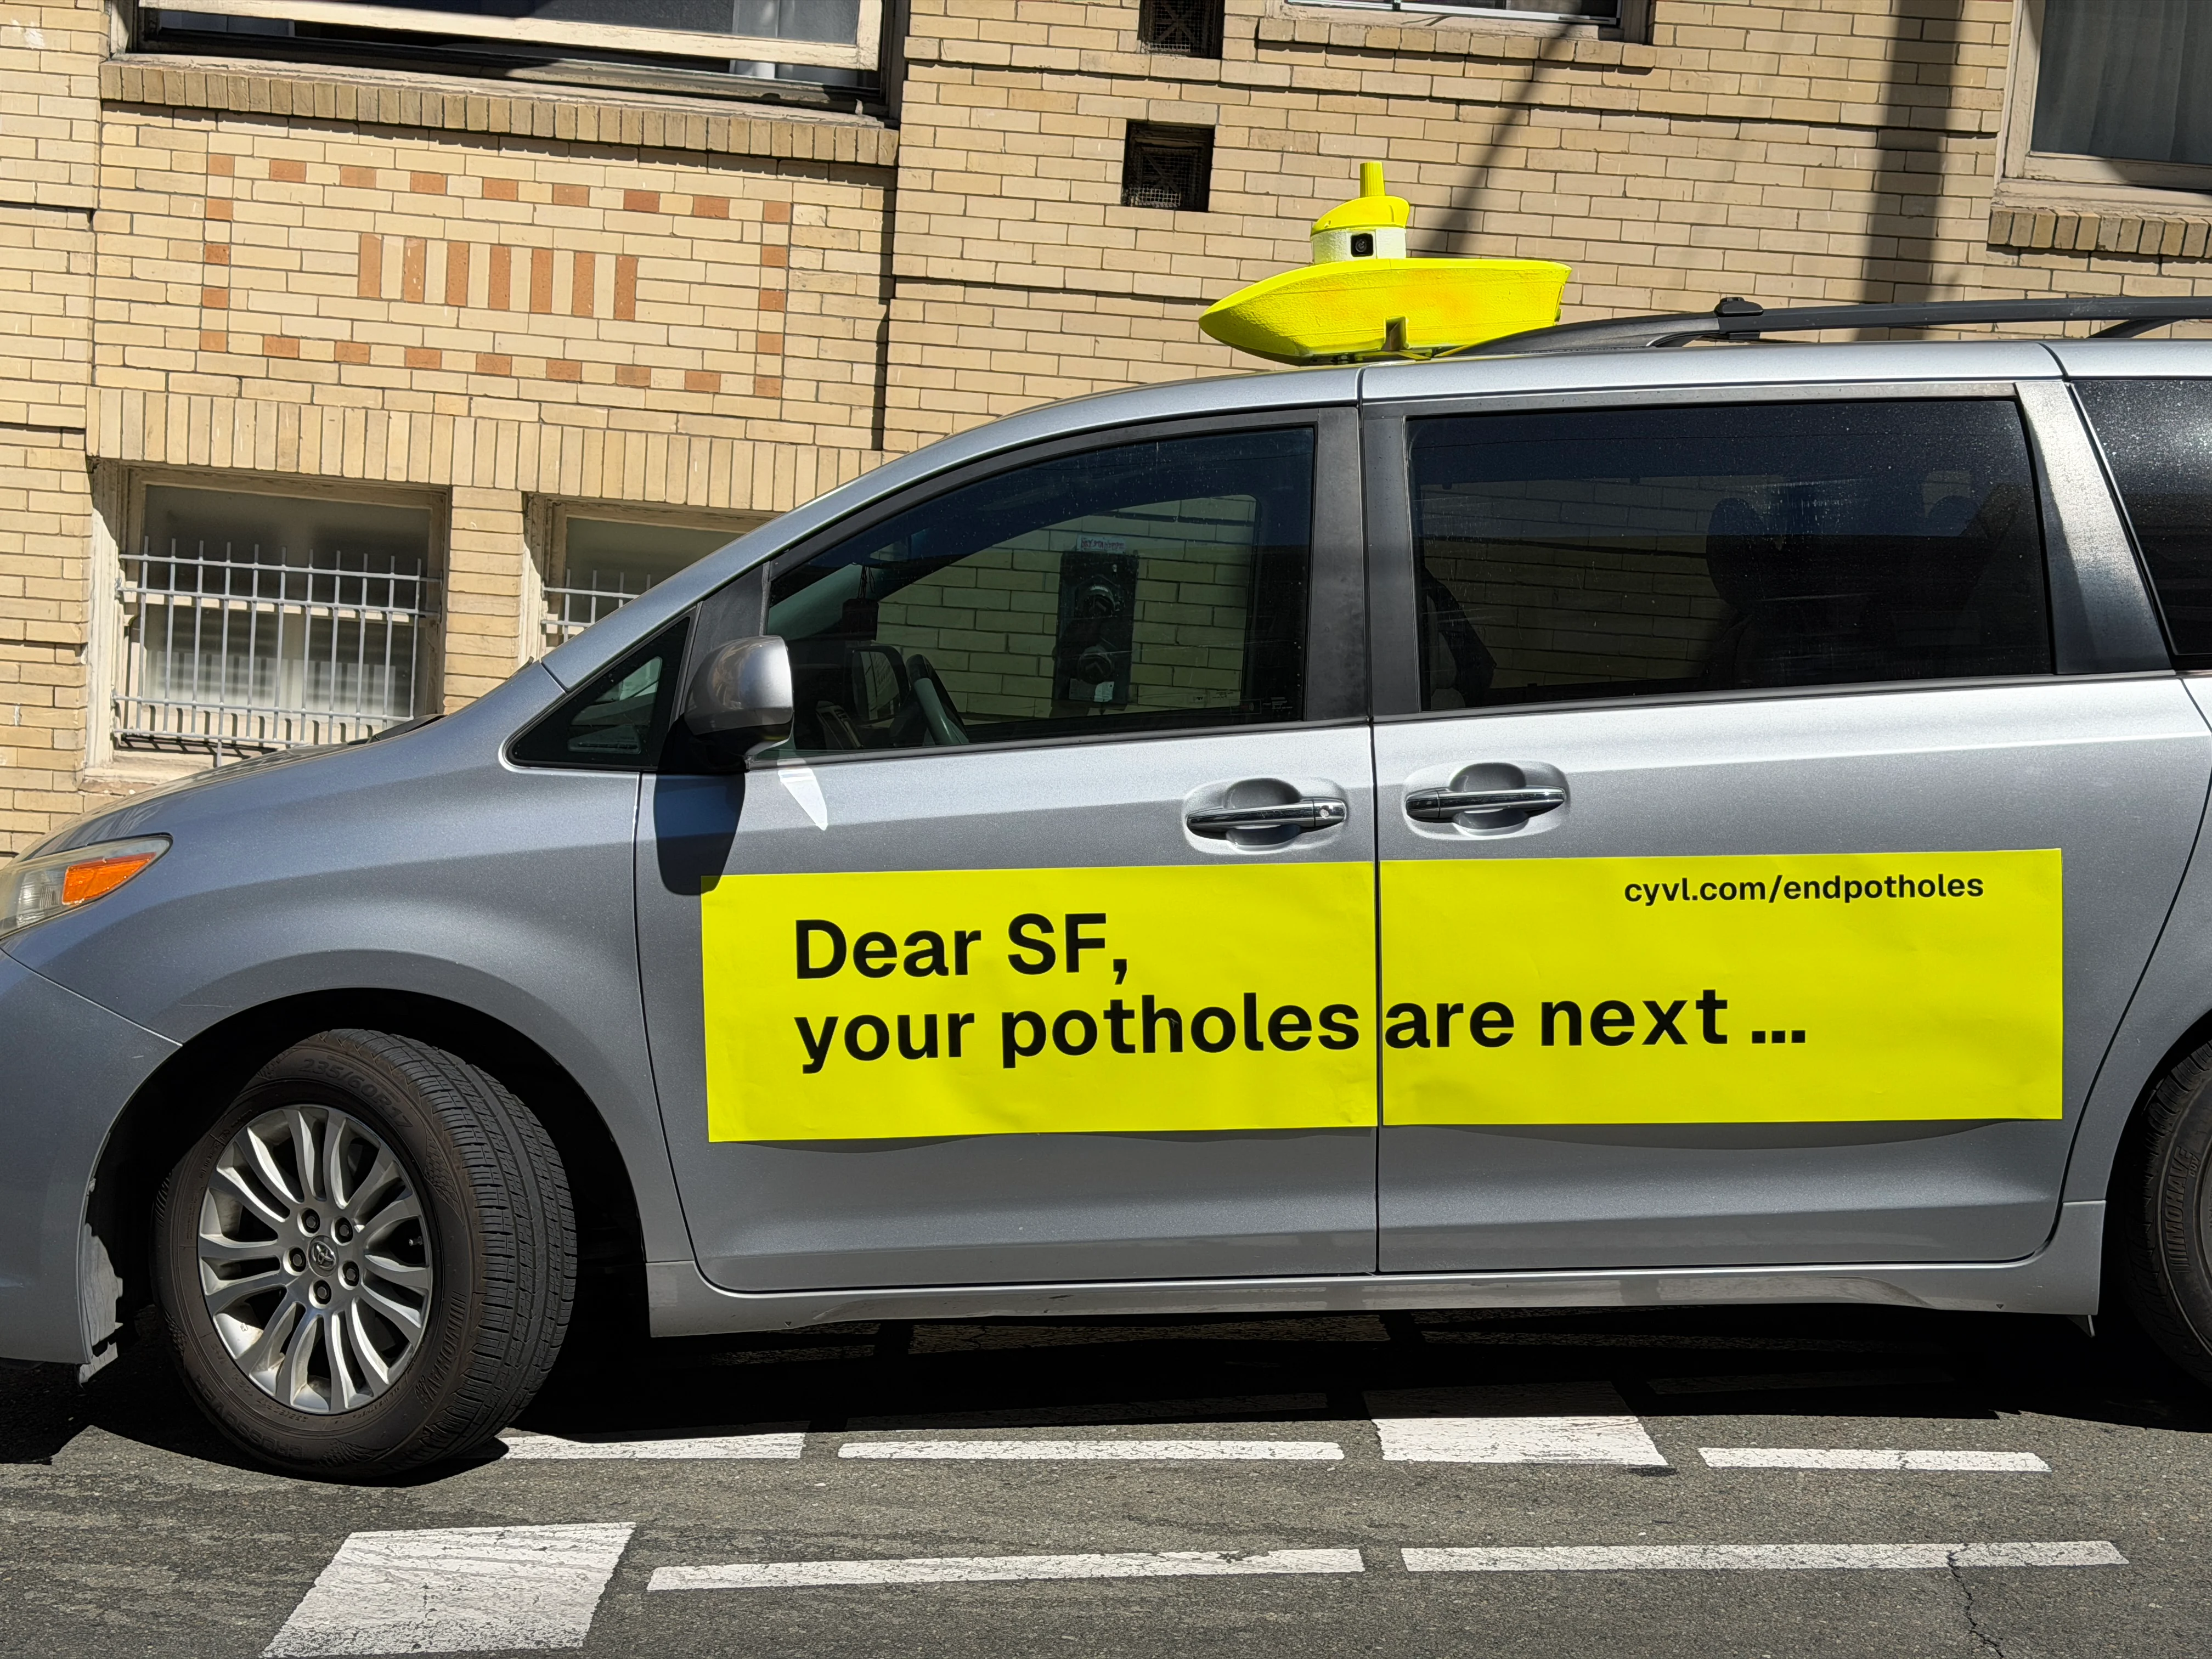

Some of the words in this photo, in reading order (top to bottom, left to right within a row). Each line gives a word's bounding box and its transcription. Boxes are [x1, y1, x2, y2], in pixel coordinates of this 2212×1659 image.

[1624, 873, 1984, 906] cyvl.com/endpotholes
[795, 919, 982, 979] Dear
[1008, 912, 1127, 986] SF,
[794, 1011, 975, 1074] your
[1001, 992, 1360, 1069] potholes
[1385, 1001, 1515, 1049] are
[1541, 989, 1729, 1047] next
